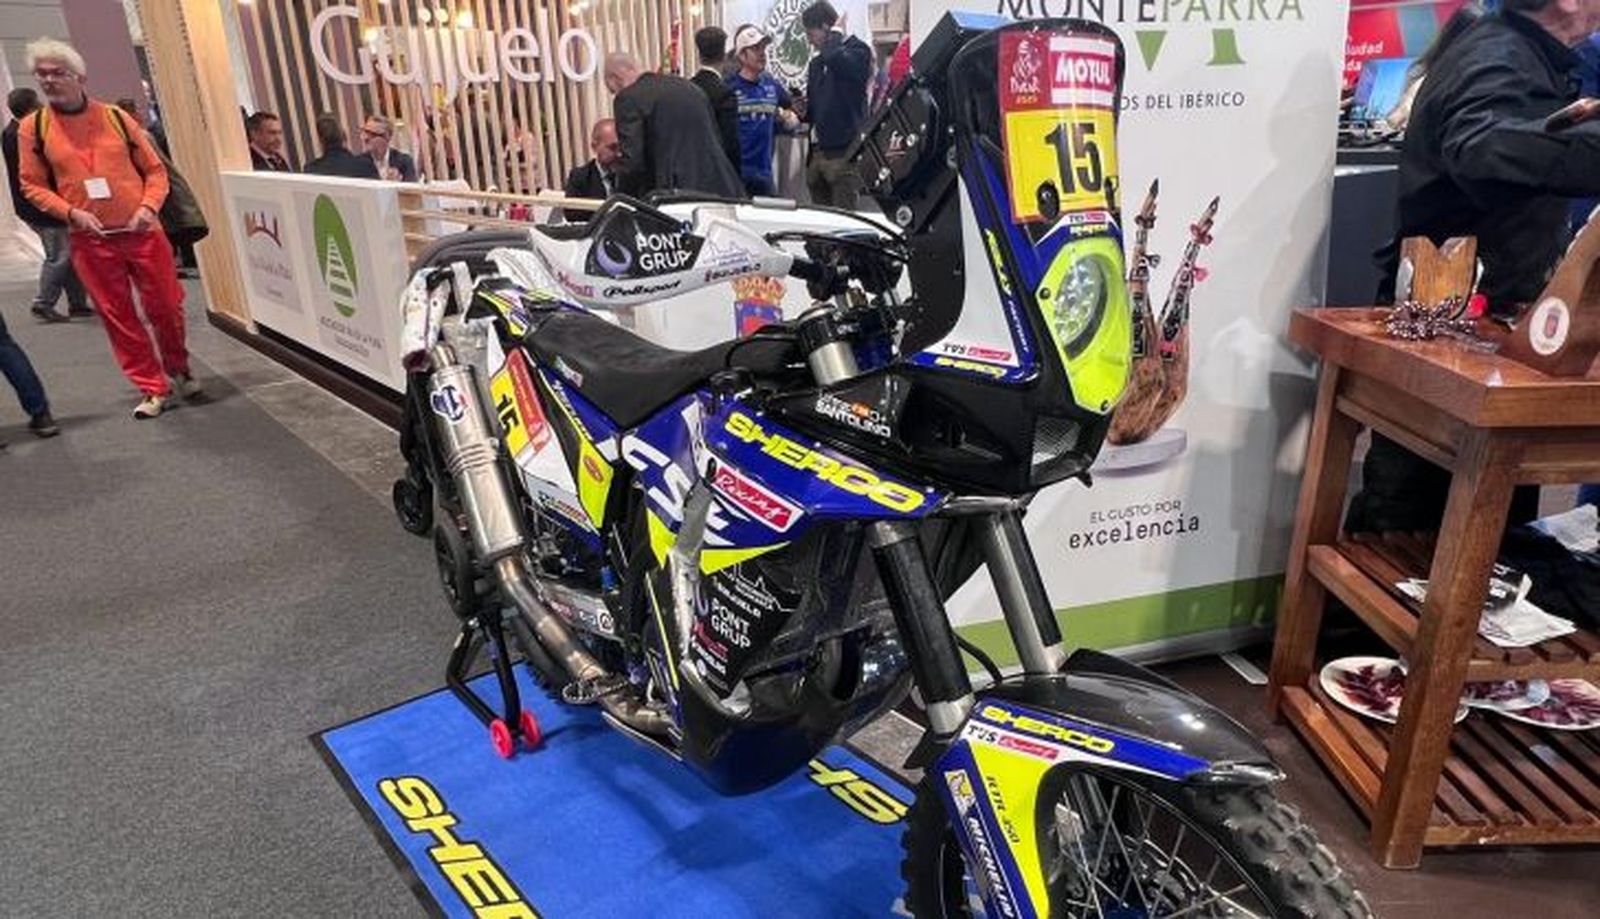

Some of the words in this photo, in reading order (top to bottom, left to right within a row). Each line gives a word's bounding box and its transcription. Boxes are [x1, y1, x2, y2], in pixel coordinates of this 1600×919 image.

[1056, 53, 1111, 85] MOTUL
[1146, 94, 1173, 109] DEL
[1044, 122, 1102, 194] 15
[635, 231, 683, 252] PONT
[639, 250, 693, 272] GRUP
[725, 411, 925, 514] SHERCO
[715, 470, 788, 521] Racing
[1090, 511, 1106, 524] EL
[1108, 503, 1152, 520] GUSTO
[1155, 500, 1182, 514] POR
[1069, 513, 1200, 549] excelencia
[711, 597, 750, 635] PONT
[711, 614, 751, 649] GRUP
[968, 724, 998, 743] TVS
[982, 705, 1115, 753] SHERCO
[377, 775, 542, 919] SHE
